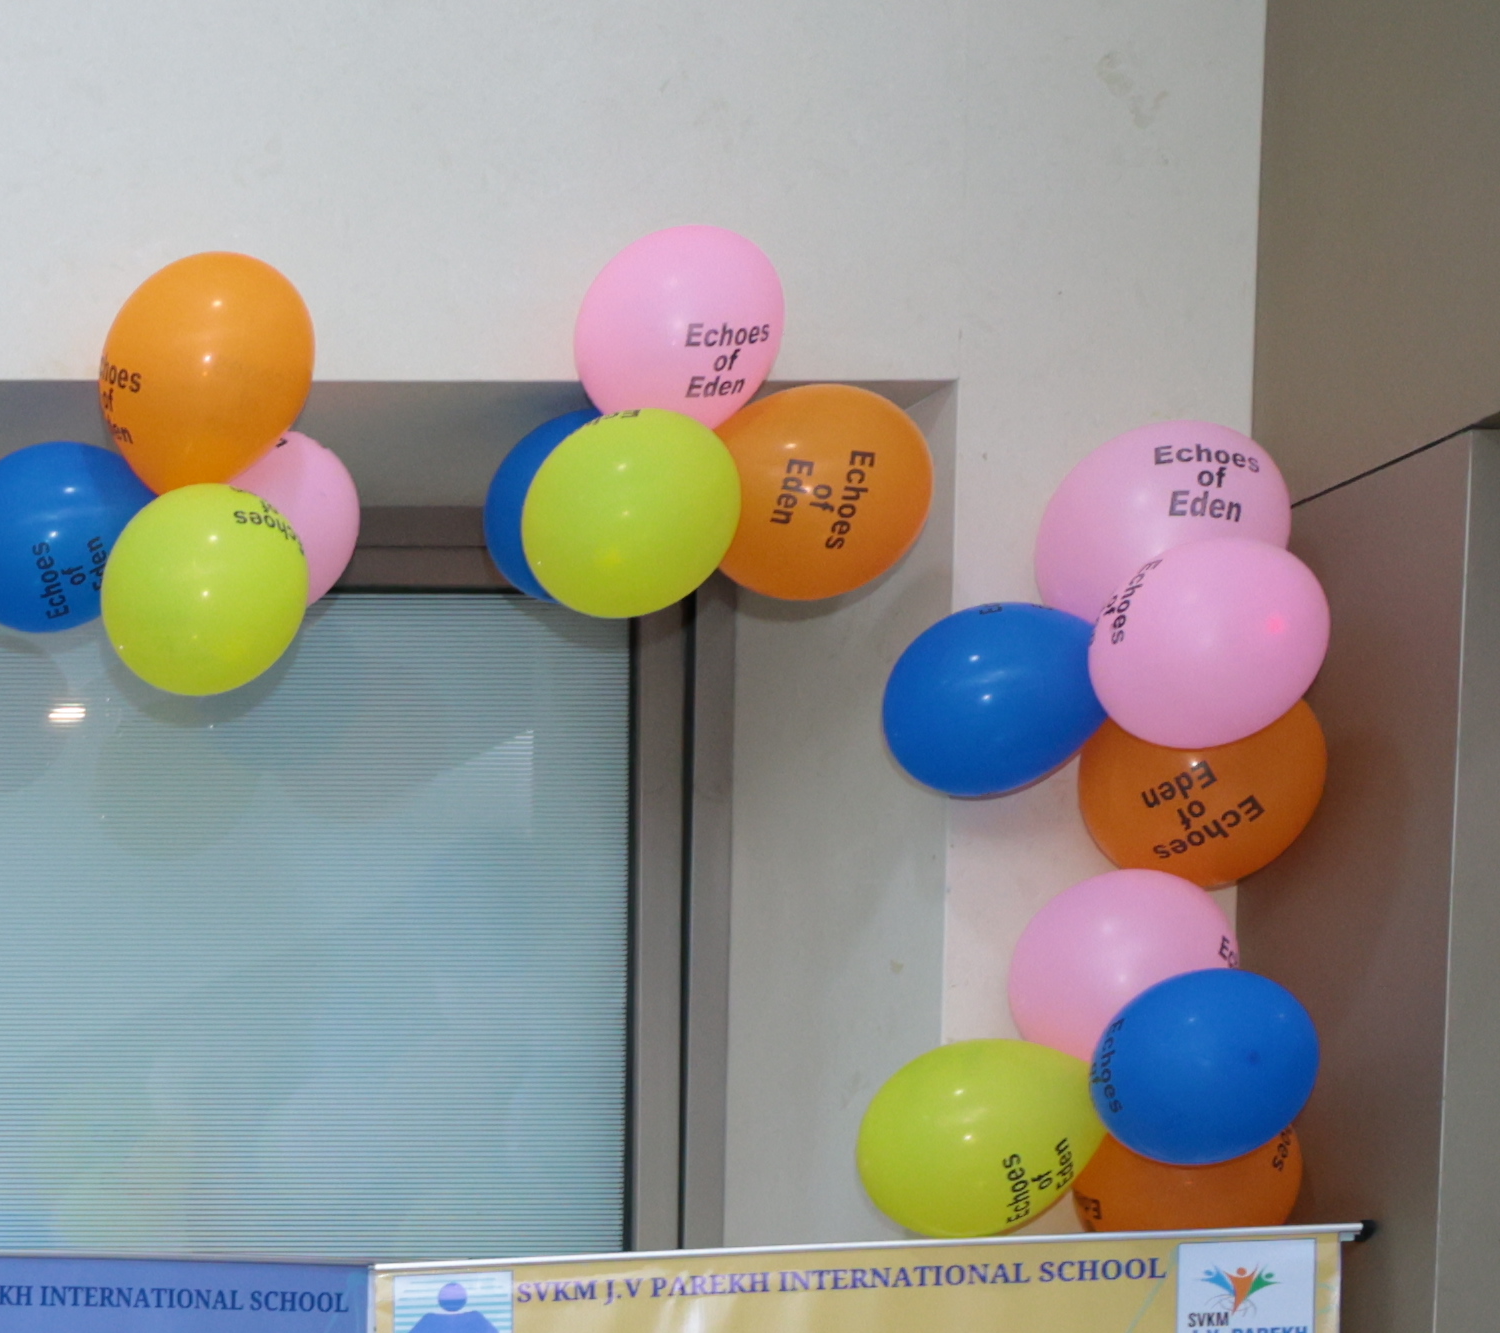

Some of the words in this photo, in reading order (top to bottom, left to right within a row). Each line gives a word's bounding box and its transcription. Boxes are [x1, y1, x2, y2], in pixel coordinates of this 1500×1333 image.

[686, 323, 771, 348] Echoes
[713, 349, 739, 371] of
[686, 376, 746, 399] Eden
[1154, 443, 1260, 475] Echoes
[770, 459, 814, 526] Eden
[1196, 465, 1227, 489] of
[811, 485, 831, 513] of
[824, 451, 875, 550] Echoes
[1168, 491, 1242, 523] Eden
[1140, 762, 1217, 809] Eden
[1152, 796, 1265, 860] Echoes
[1177, 798, 1205, 829] of
[517, 1280, 598, 1303] SVKM
[602, 1279, 645, 1305] J.V
[651, 1271, 770, 1299] PAREKH
[778, 1262, 1030, 1292] INTERNATIONAL
[1040, 1258, 1167, 1283] SCHOOL
[39, 1285, 243, 1311] INTERNATIONAL
[250, 1289, 349, 1313] SCHOOL
[1188, 1312, 1229, 1327] SVKM
